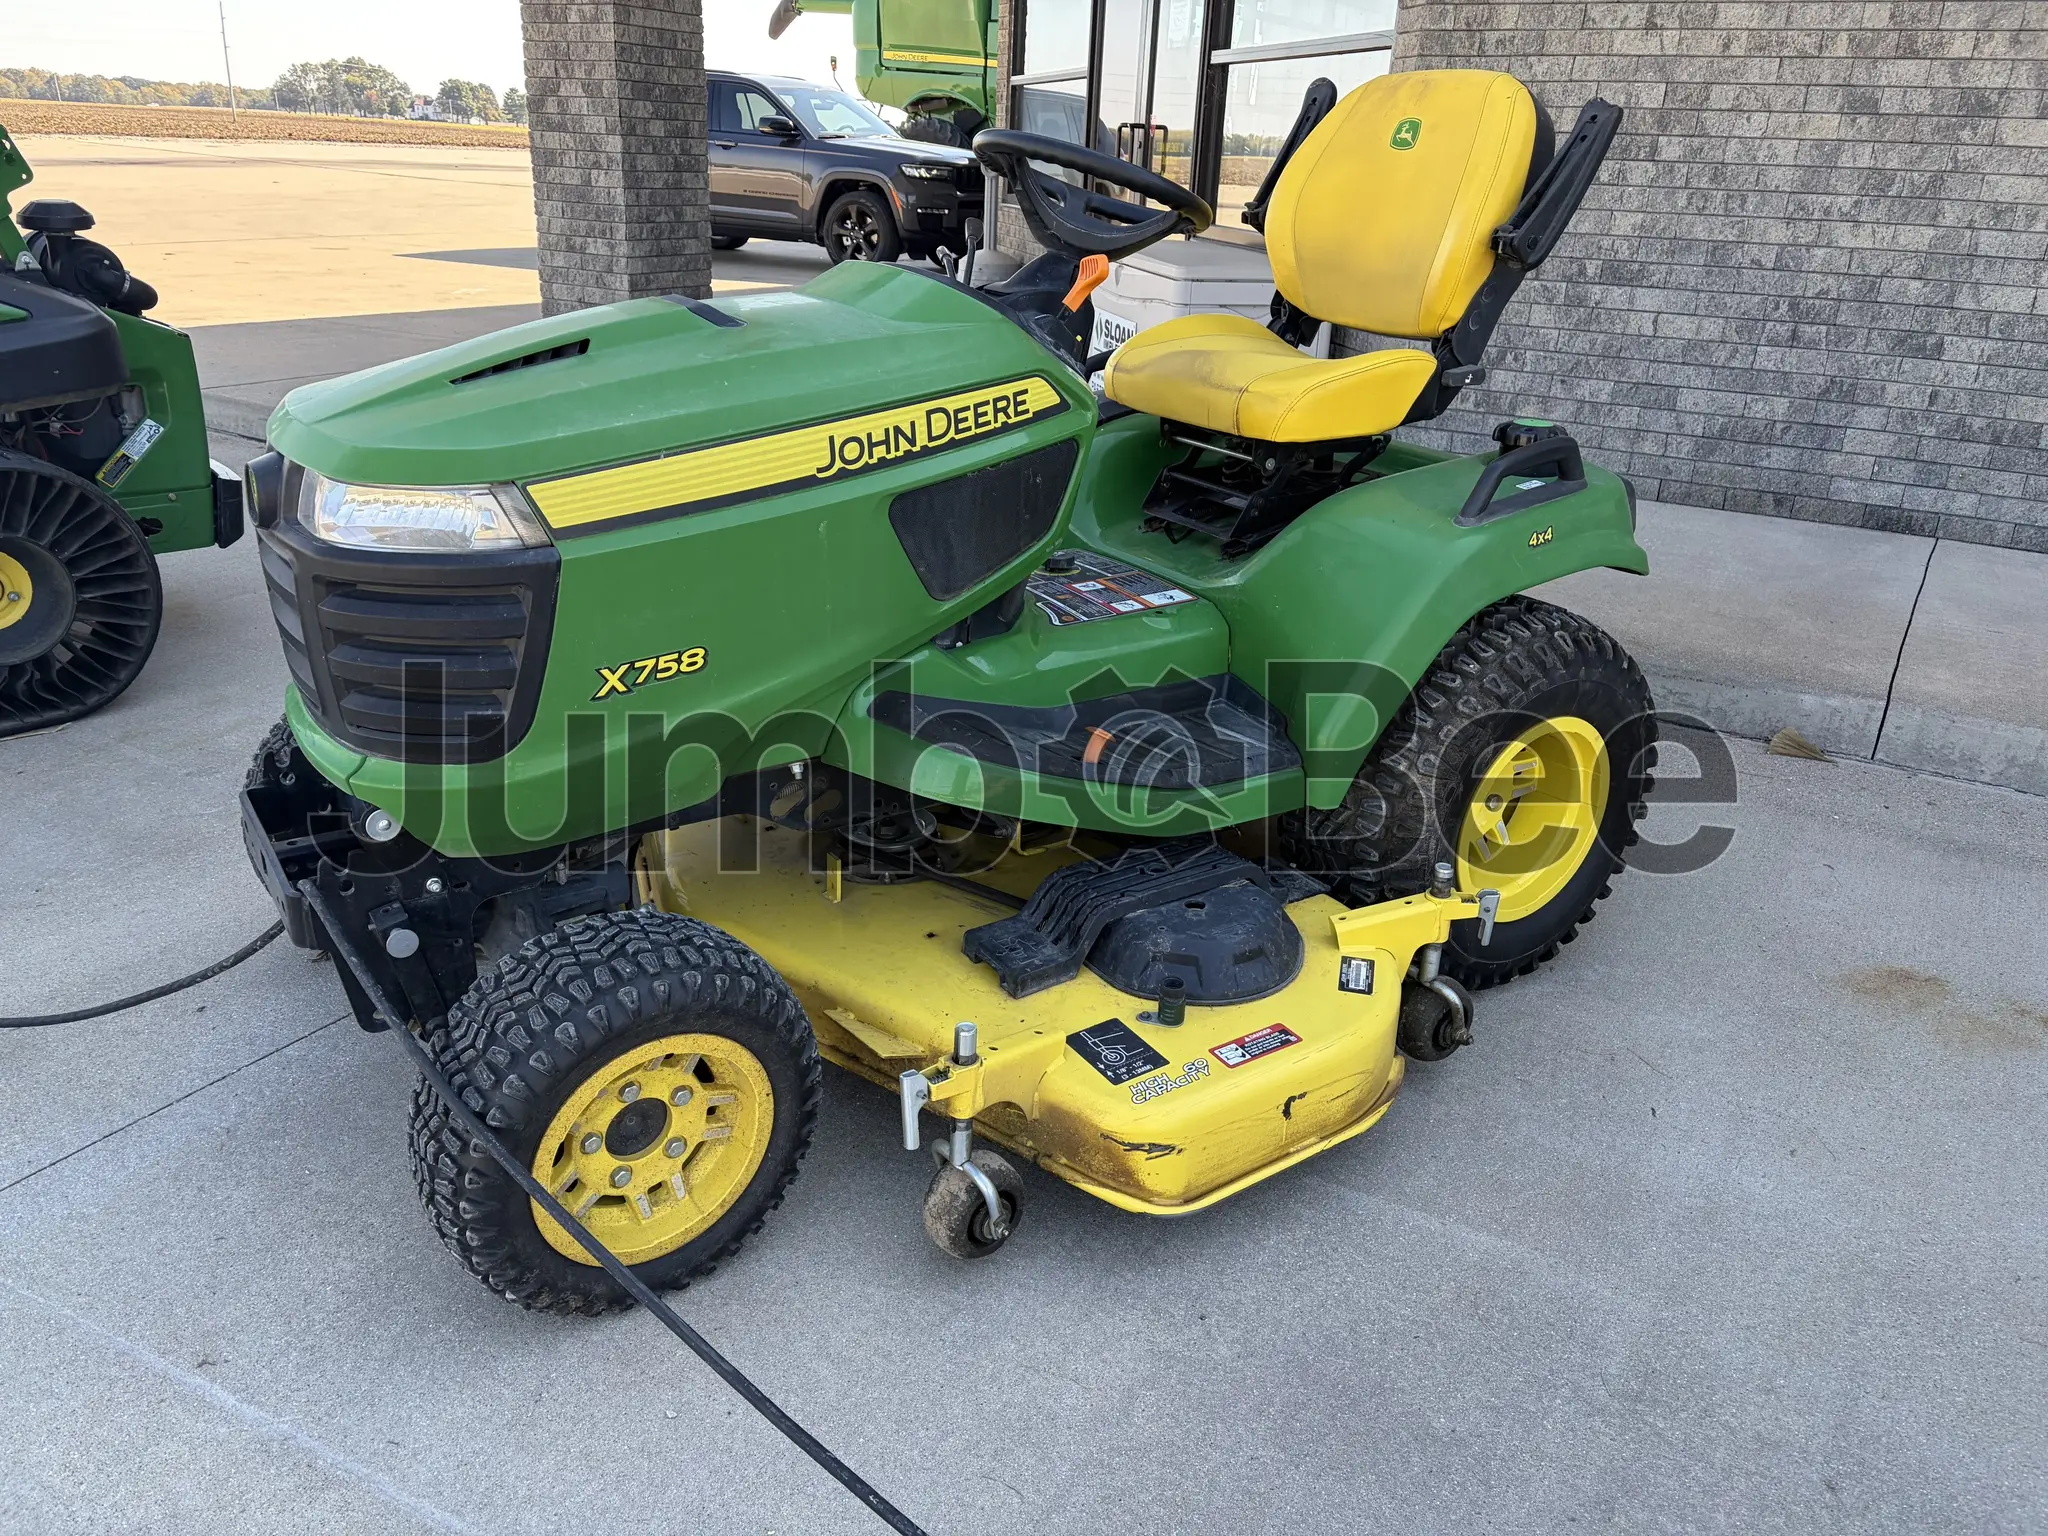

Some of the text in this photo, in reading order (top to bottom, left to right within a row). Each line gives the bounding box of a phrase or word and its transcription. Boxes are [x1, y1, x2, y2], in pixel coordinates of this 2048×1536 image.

[908, 53, 929, 61] DEERE
[816, 388, 1030, 475] JOHN DEERE
[1528, 525, 1553, 547] 4x4
[591, 646, 708, 700] X758
[1248, 1028, 1273, 1038] DANGER
[1129, 1058, 1208, 1096] HIGH 60
[1131, 1066, 1211, 1104] CAPACITY
